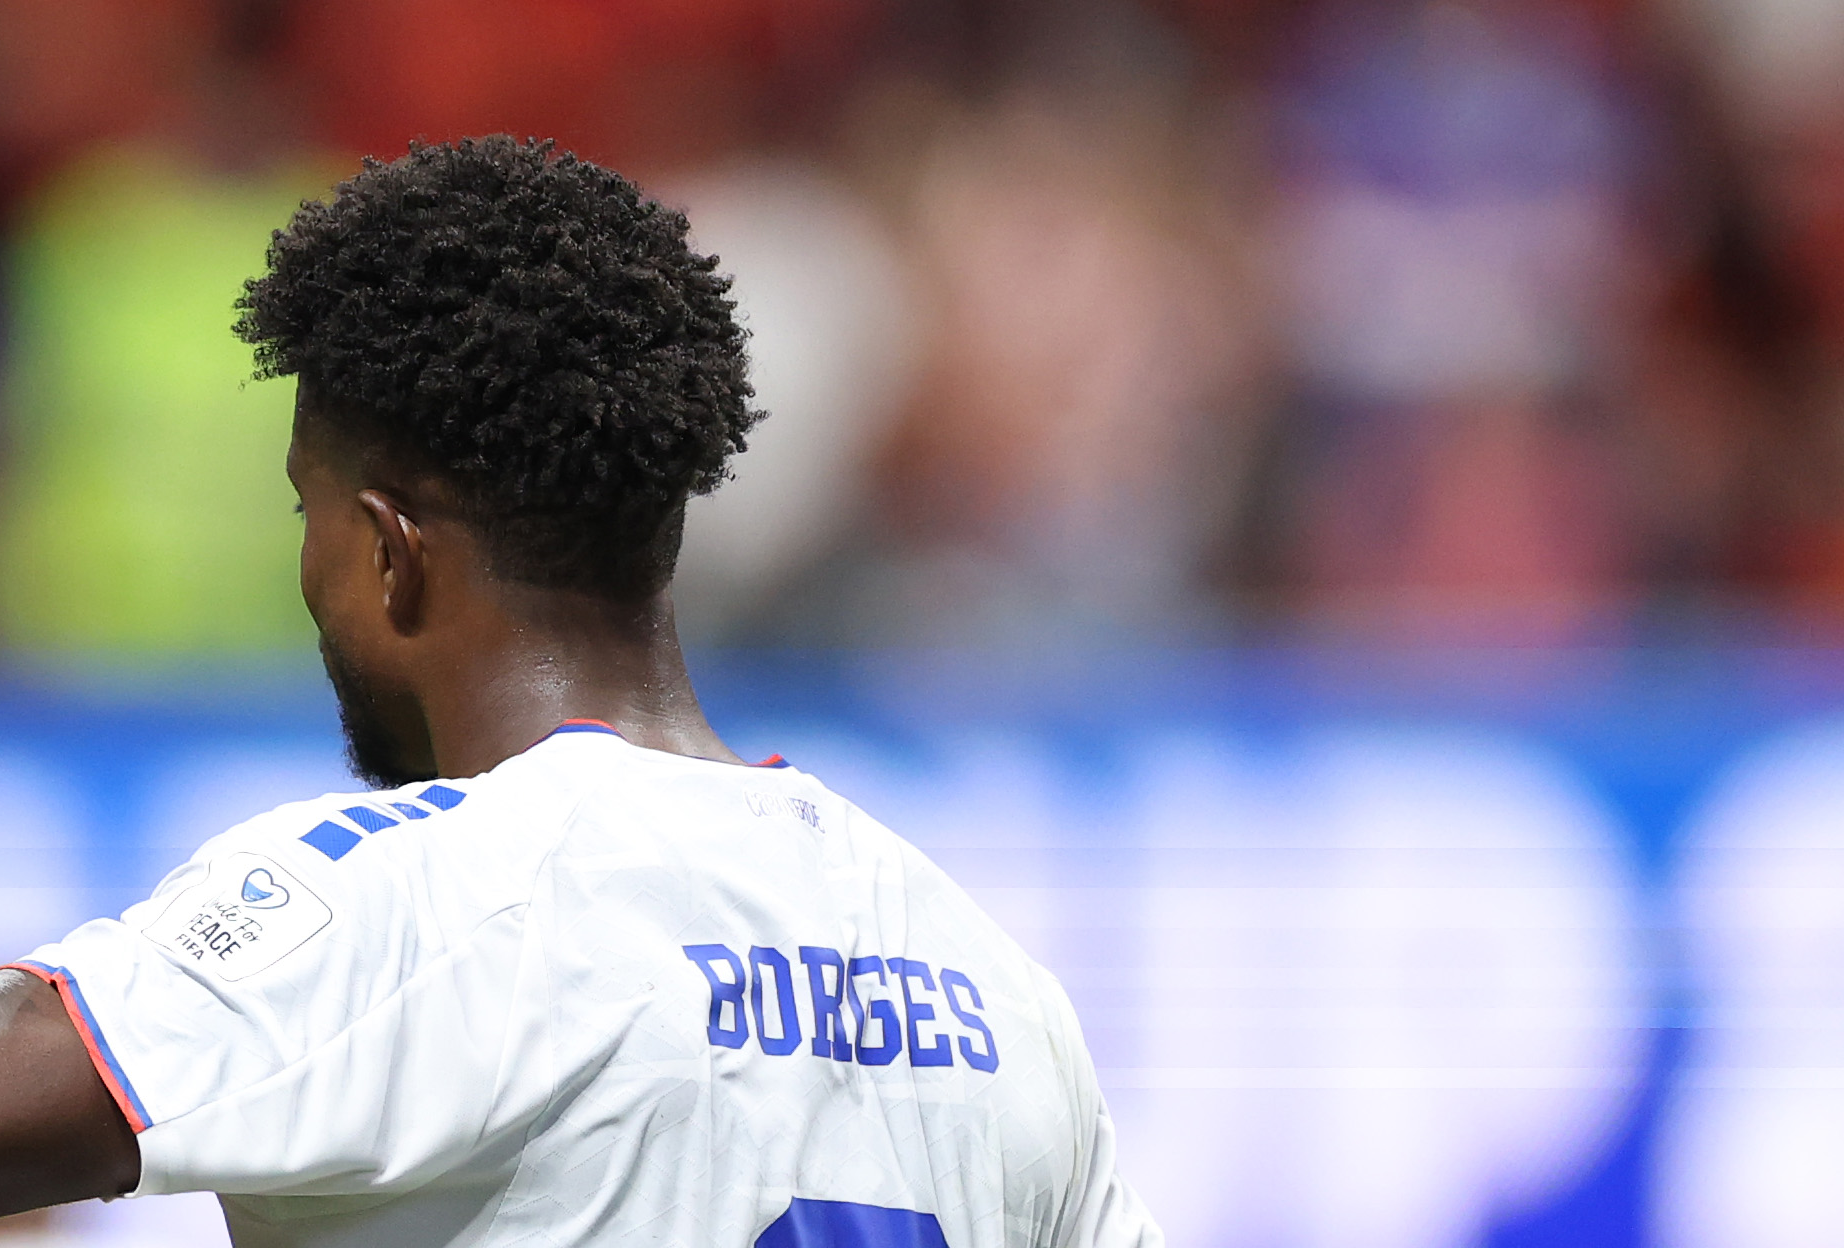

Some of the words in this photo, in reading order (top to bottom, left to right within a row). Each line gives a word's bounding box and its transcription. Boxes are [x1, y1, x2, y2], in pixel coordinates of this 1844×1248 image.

[174, 932, 205, 960] FIFA
[183, 912, 242, 961] PEACE
[681, 943, 1000, 1074] BORGES
